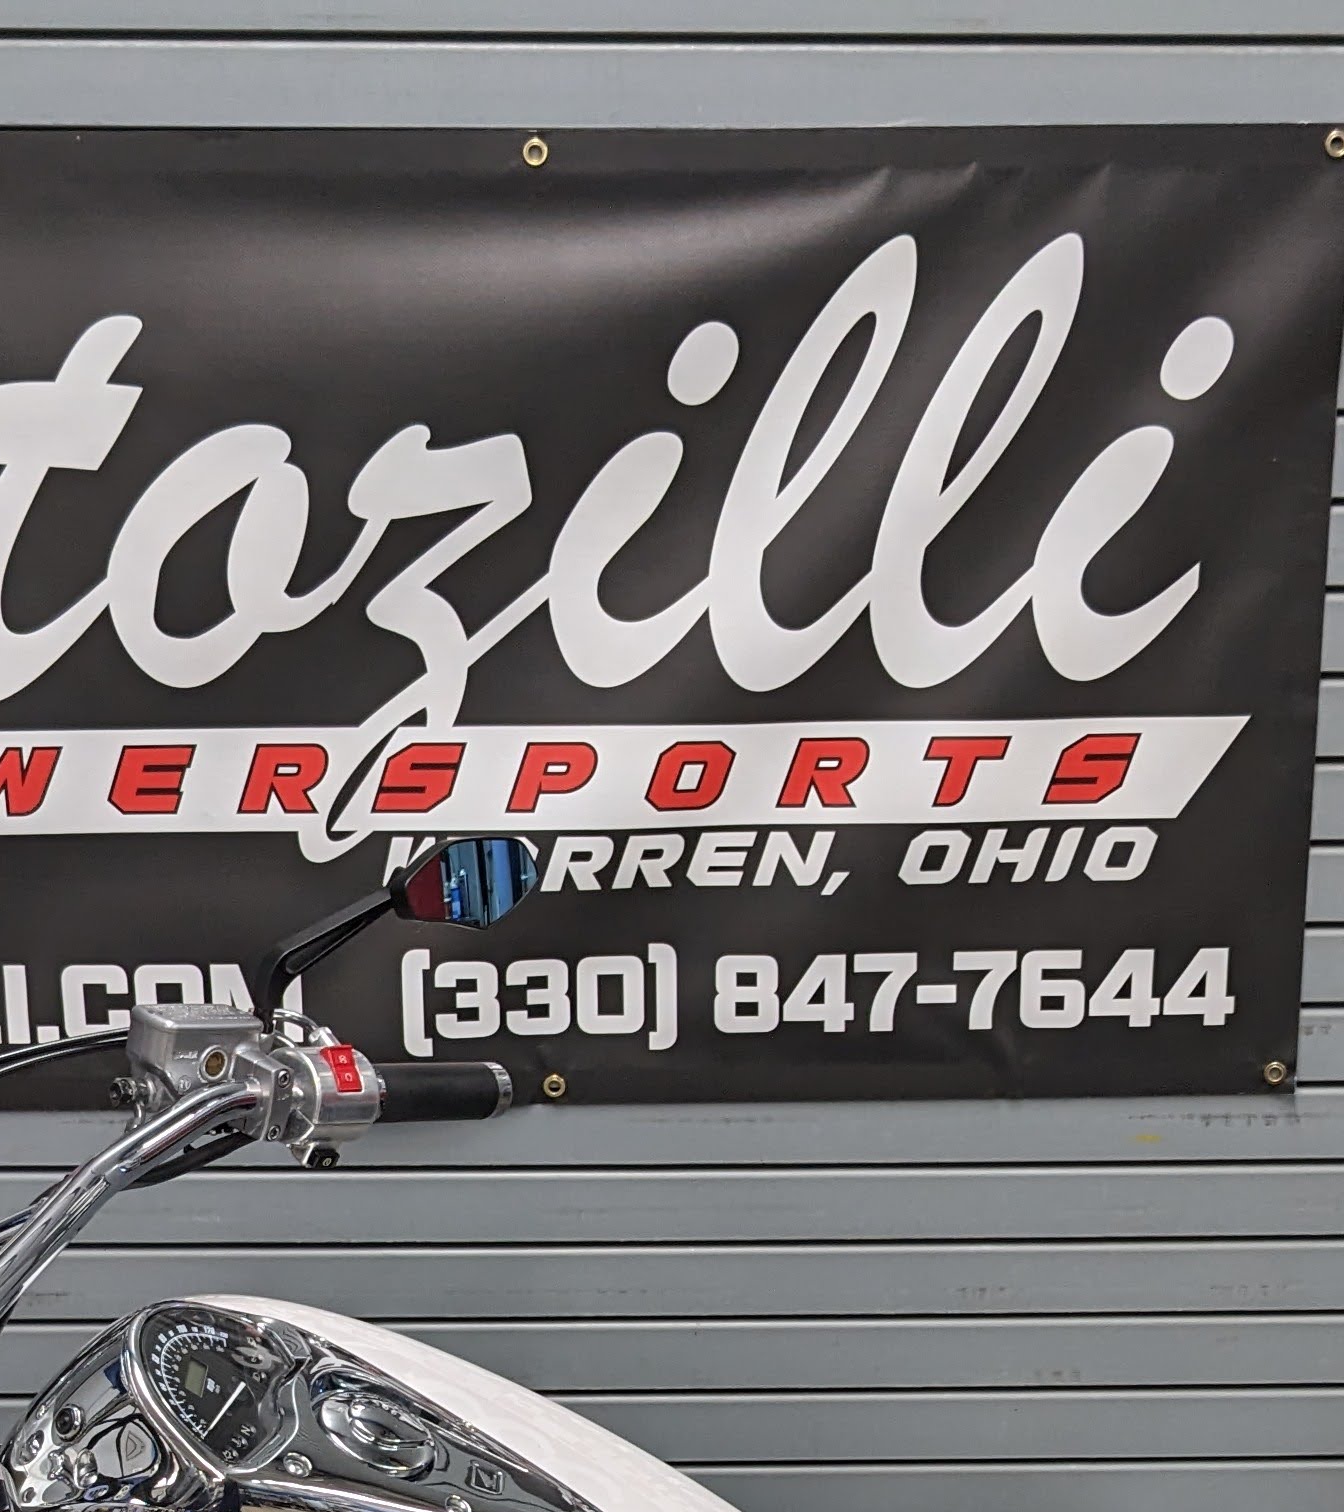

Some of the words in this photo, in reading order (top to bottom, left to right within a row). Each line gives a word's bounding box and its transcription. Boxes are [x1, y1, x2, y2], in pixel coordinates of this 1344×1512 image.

[383, 831, 851, 896] RREN,
[898, 826, 1159, 885] OHIO
[401, 943, 678, 1057] (330)
[714, 947, 1236, 1034] 847-7644
